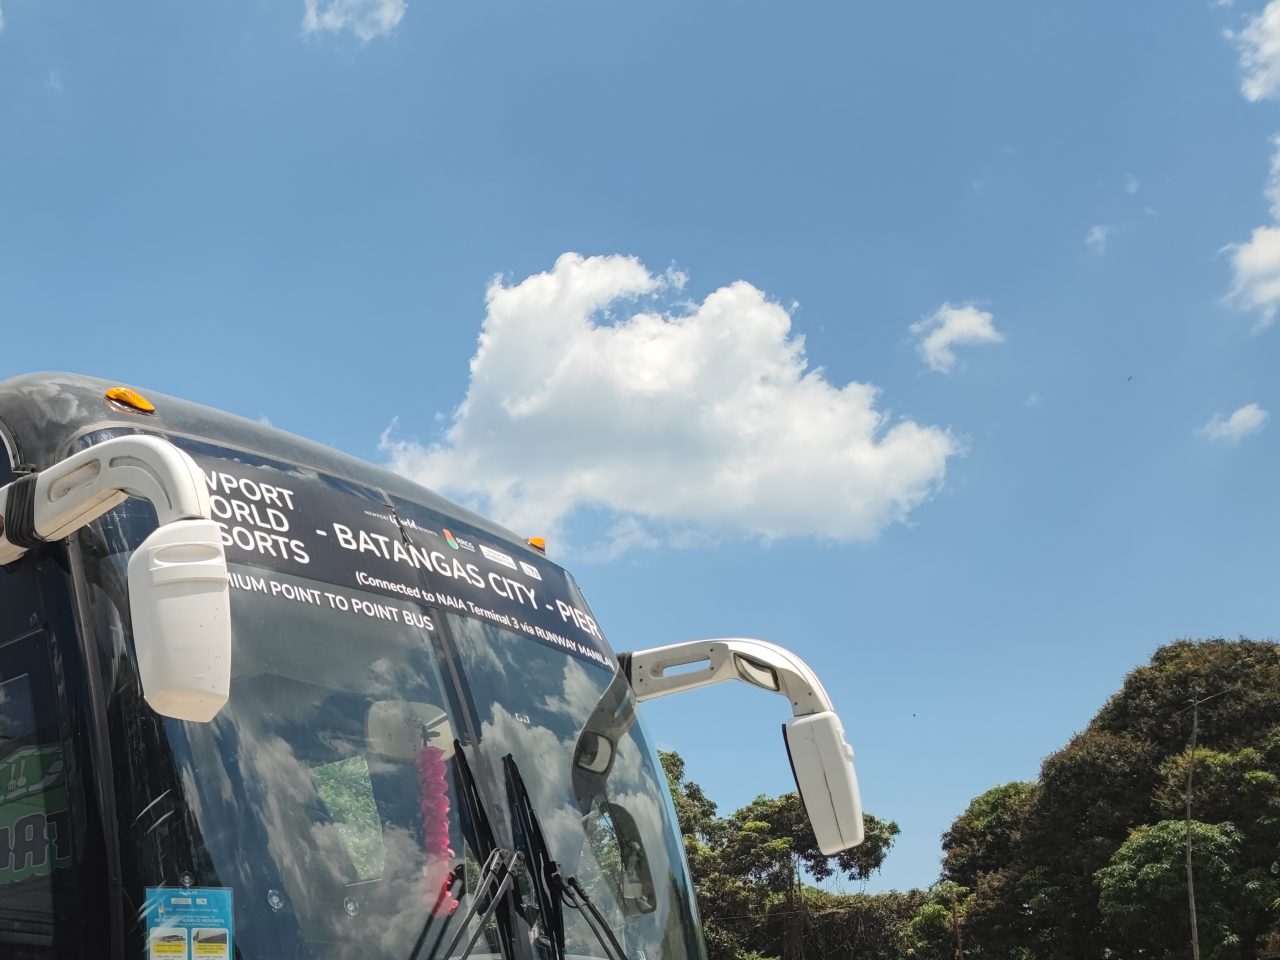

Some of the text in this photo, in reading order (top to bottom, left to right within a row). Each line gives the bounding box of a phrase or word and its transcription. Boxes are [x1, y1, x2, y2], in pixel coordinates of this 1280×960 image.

[206, 470, 294, 510] PORT
[209, 495, 289, 532] ORLD
[217, 521, 310, 564] SORTS
[332, 522, 486, 589] BATANGAS
[487, 572, 538, 610] CITY
[555, 598, 603, 641] PIER
[269, 580, 321, 606] POINT
[324, 592, 349, 611] TO
[350, 597, 399, 623] POINT
[402, 610, 434, 631] BUS
[355, 570, 421, 599] (Connected
[421, 589, 435, 603] to
[435, 593, 468, 612] NAIA
[466, 600, 512, 627] Terminal
[511, 617, 520, 630] 3
[520, 621, 535, 636] via
[534, 626, 577, 652] RUNWAY
